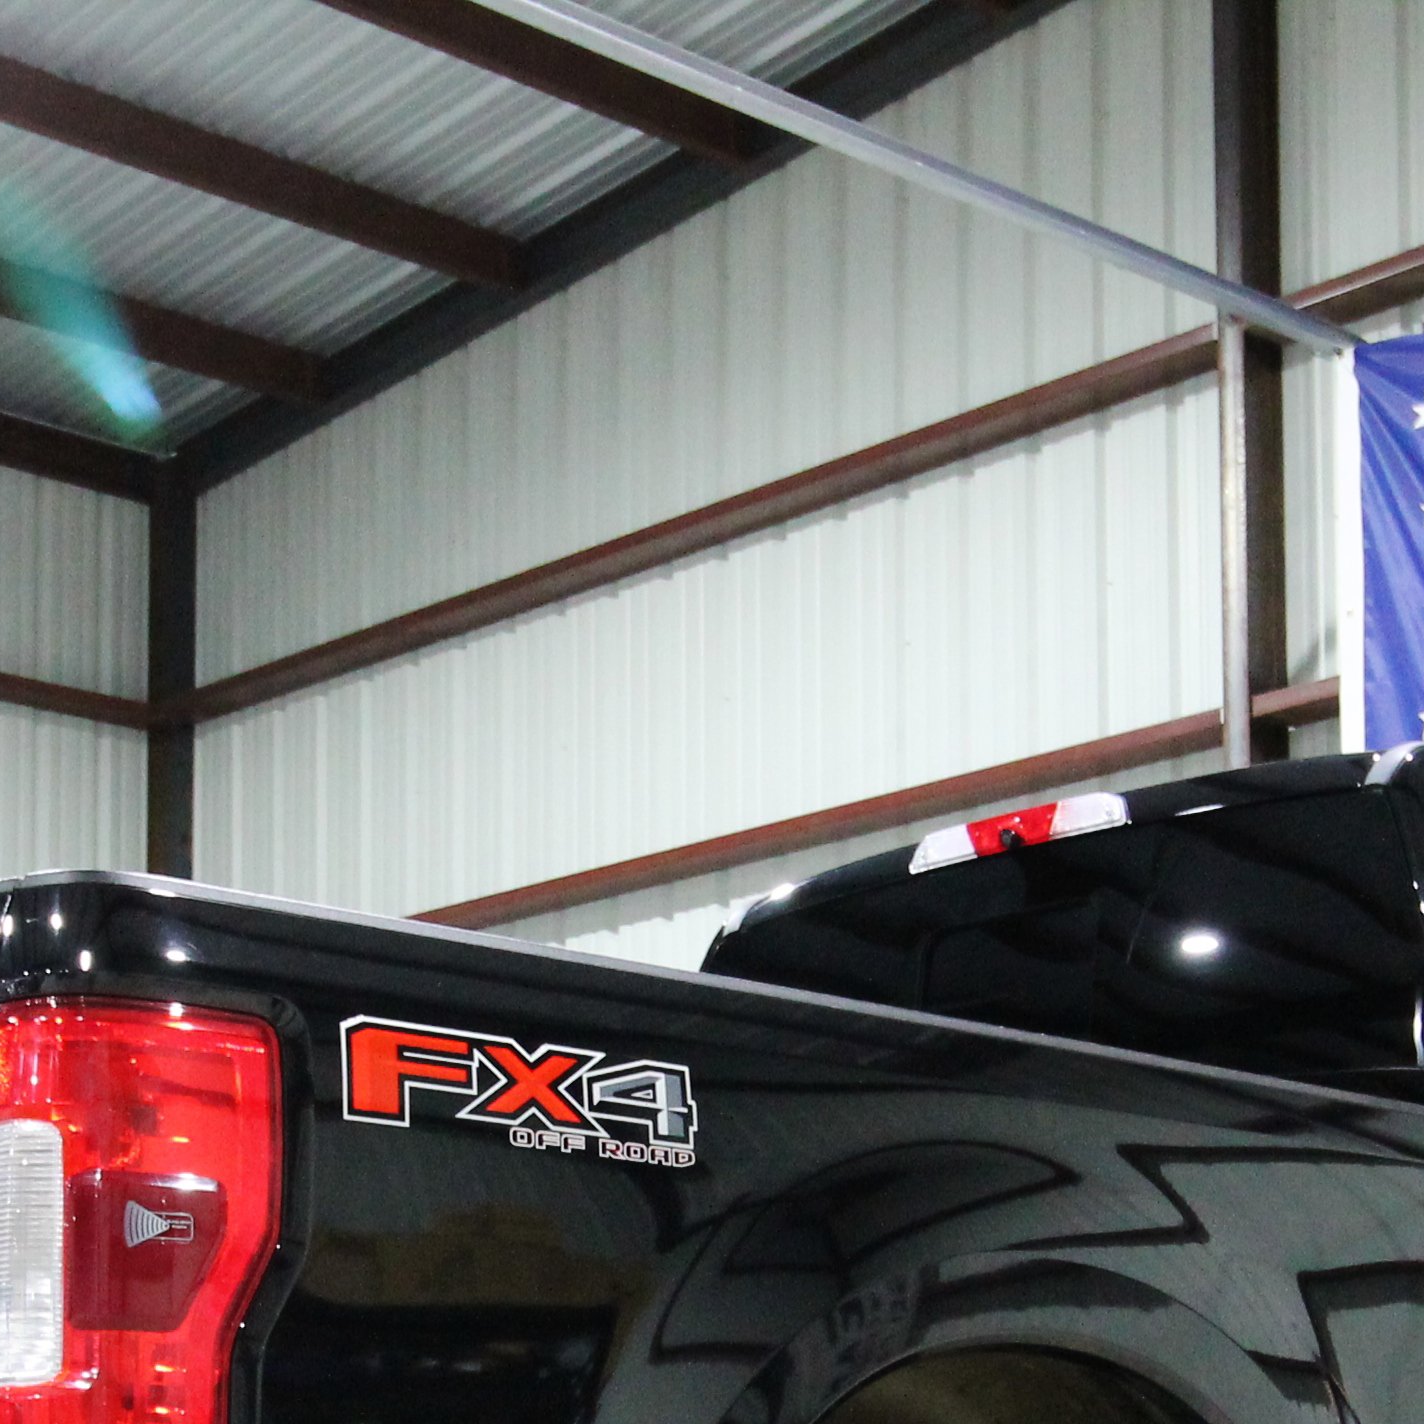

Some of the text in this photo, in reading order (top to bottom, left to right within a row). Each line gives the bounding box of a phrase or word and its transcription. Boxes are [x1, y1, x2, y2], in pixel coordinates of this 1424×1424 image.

[339, 1014, 698, 1149] FX4
[509, 1126, 695, 1168] OFF ROAD
